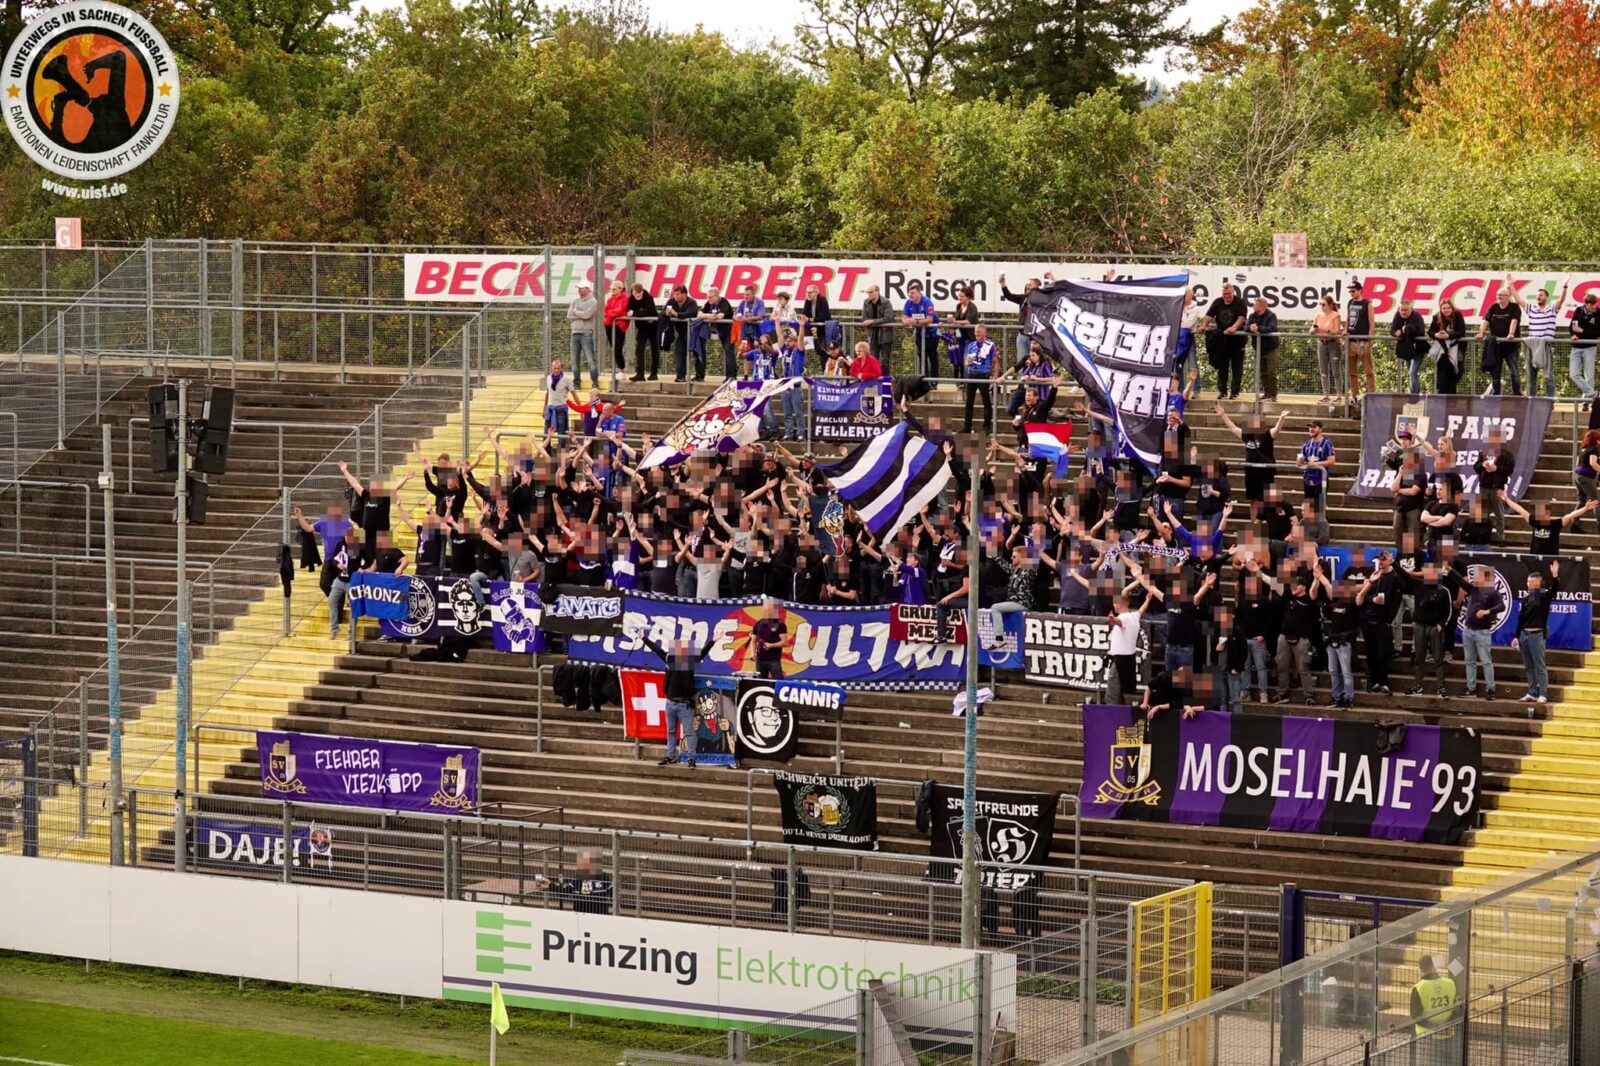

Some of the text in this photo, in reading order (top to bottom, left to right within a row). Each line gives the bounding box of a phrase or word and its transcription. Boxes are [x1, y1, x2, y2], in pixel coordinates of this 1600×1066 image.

[817, 386, 859, 395] EINTRACHT
[817, 394, 840, 402] TRIER
[816, 416, 848, 424] FANCLUB
[815, 425, 886, 438] FELLERTA
[348, 583, 400, 605] CHAONZ
[908, 624, 956, 641] MEZ
[778, 686, 840, 710] CANNIS
[315, 749, 380, 769] FIEHRER
[775, 769, 868, 788] SCHWEICH UNITED
[947, 797, 1039, 817] SPTFREUNDE
[782, 828, 805, 837] OU'LL
[209, 830, 301, 866] DAJE!
[953, 867, 1030, 889] TIER
[543, 930, 979, 1003] Prinzing Elektrotechnik
[1431, 996, 1450, 1009] 223
